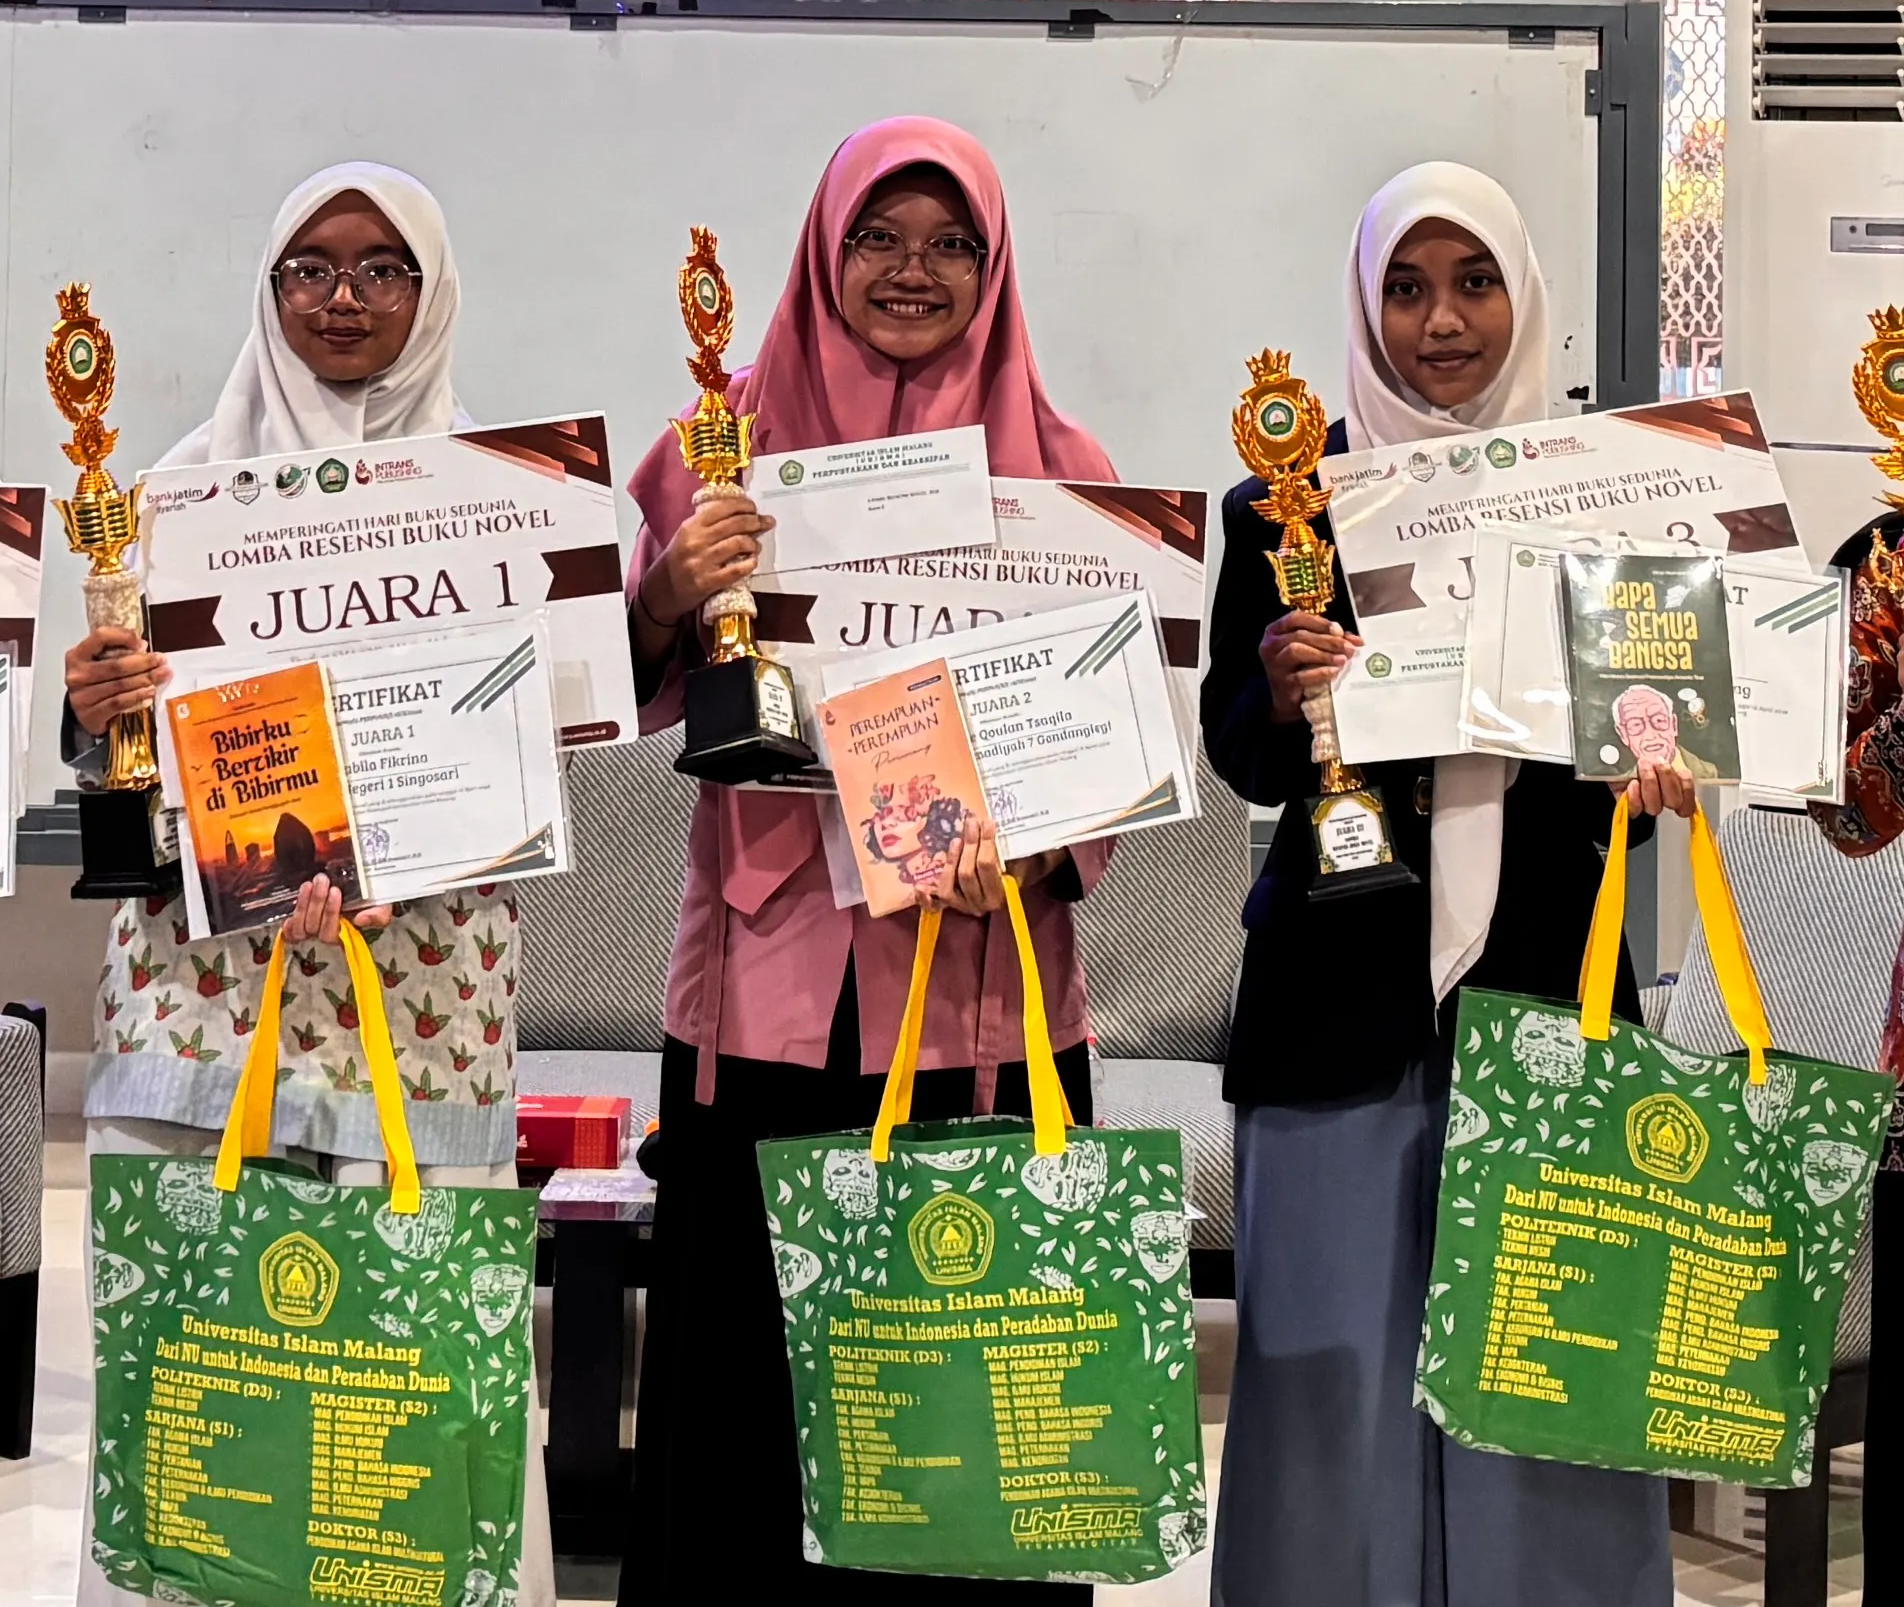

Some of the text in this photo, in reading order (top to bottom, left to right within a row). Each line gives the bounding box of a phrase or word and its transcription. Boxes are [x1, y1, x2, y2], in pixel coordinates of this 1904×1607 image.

[145, 486, 204, 504] bankjatim
[243, 499, 517, 544] MEMPERINGATI HARI BUKU SEDUNIA
[207, 509, 557, 572] LOMBA RESENSI BUKU NOVEL
[1001, 549, 1109, 568] BUKU SEDUNIA
[897, 559, 1144, 591] RESENSI BUKU NOVEL
[250, 561, 520, 641] JUARA 1
[1625, 610, 1699, 644] SEMUA
[970, 692, 1032, 716] JUARA 2
[210, 717, 292, 755] Bibirku
[213, 743, 300, 782] Berzikir
[205, 765, 320, 811] di Bibirmu
[1539, 1163, 1772, 1233] Universitas Islam Malang
[1500, 1212, 1631, 1249] POLITEKNIK (D3)
[1504, 1184, 1536, 1208] Dari
[1538, 1190, 1558, 1212] NU
[1559, 1197, 1595, 1219] untuk
[1597, 1199, 1663, 1237] Indonesia
[1666, 1219, 1691, 1242] dan
[1693, 1224, 1763, 1258] Peradaban
[850, 1287, 1084, 1313] Universitas Islam Malang
[182, 1314, 421, 1366] Universitas Islam Malang
[829, 1317, 852, 1337] Dari
[854, 1320, 870, 1337] NU
[906, 1319, 970, 1342] Indonesia
[973, 1317, 999, 1336] dan
[1001, 1315, 1074, 1337] Peradaban
[1077, 1310, 1118, 1331] Dunia
[155, 1338, 451, 1393] Dari NU untuk Indonesia dan Peradaban Dunia
[829, 1344, 943, 1365] POLITEKNIK (D3)
[983, 1343, 1070, 1360] MAGISTER
